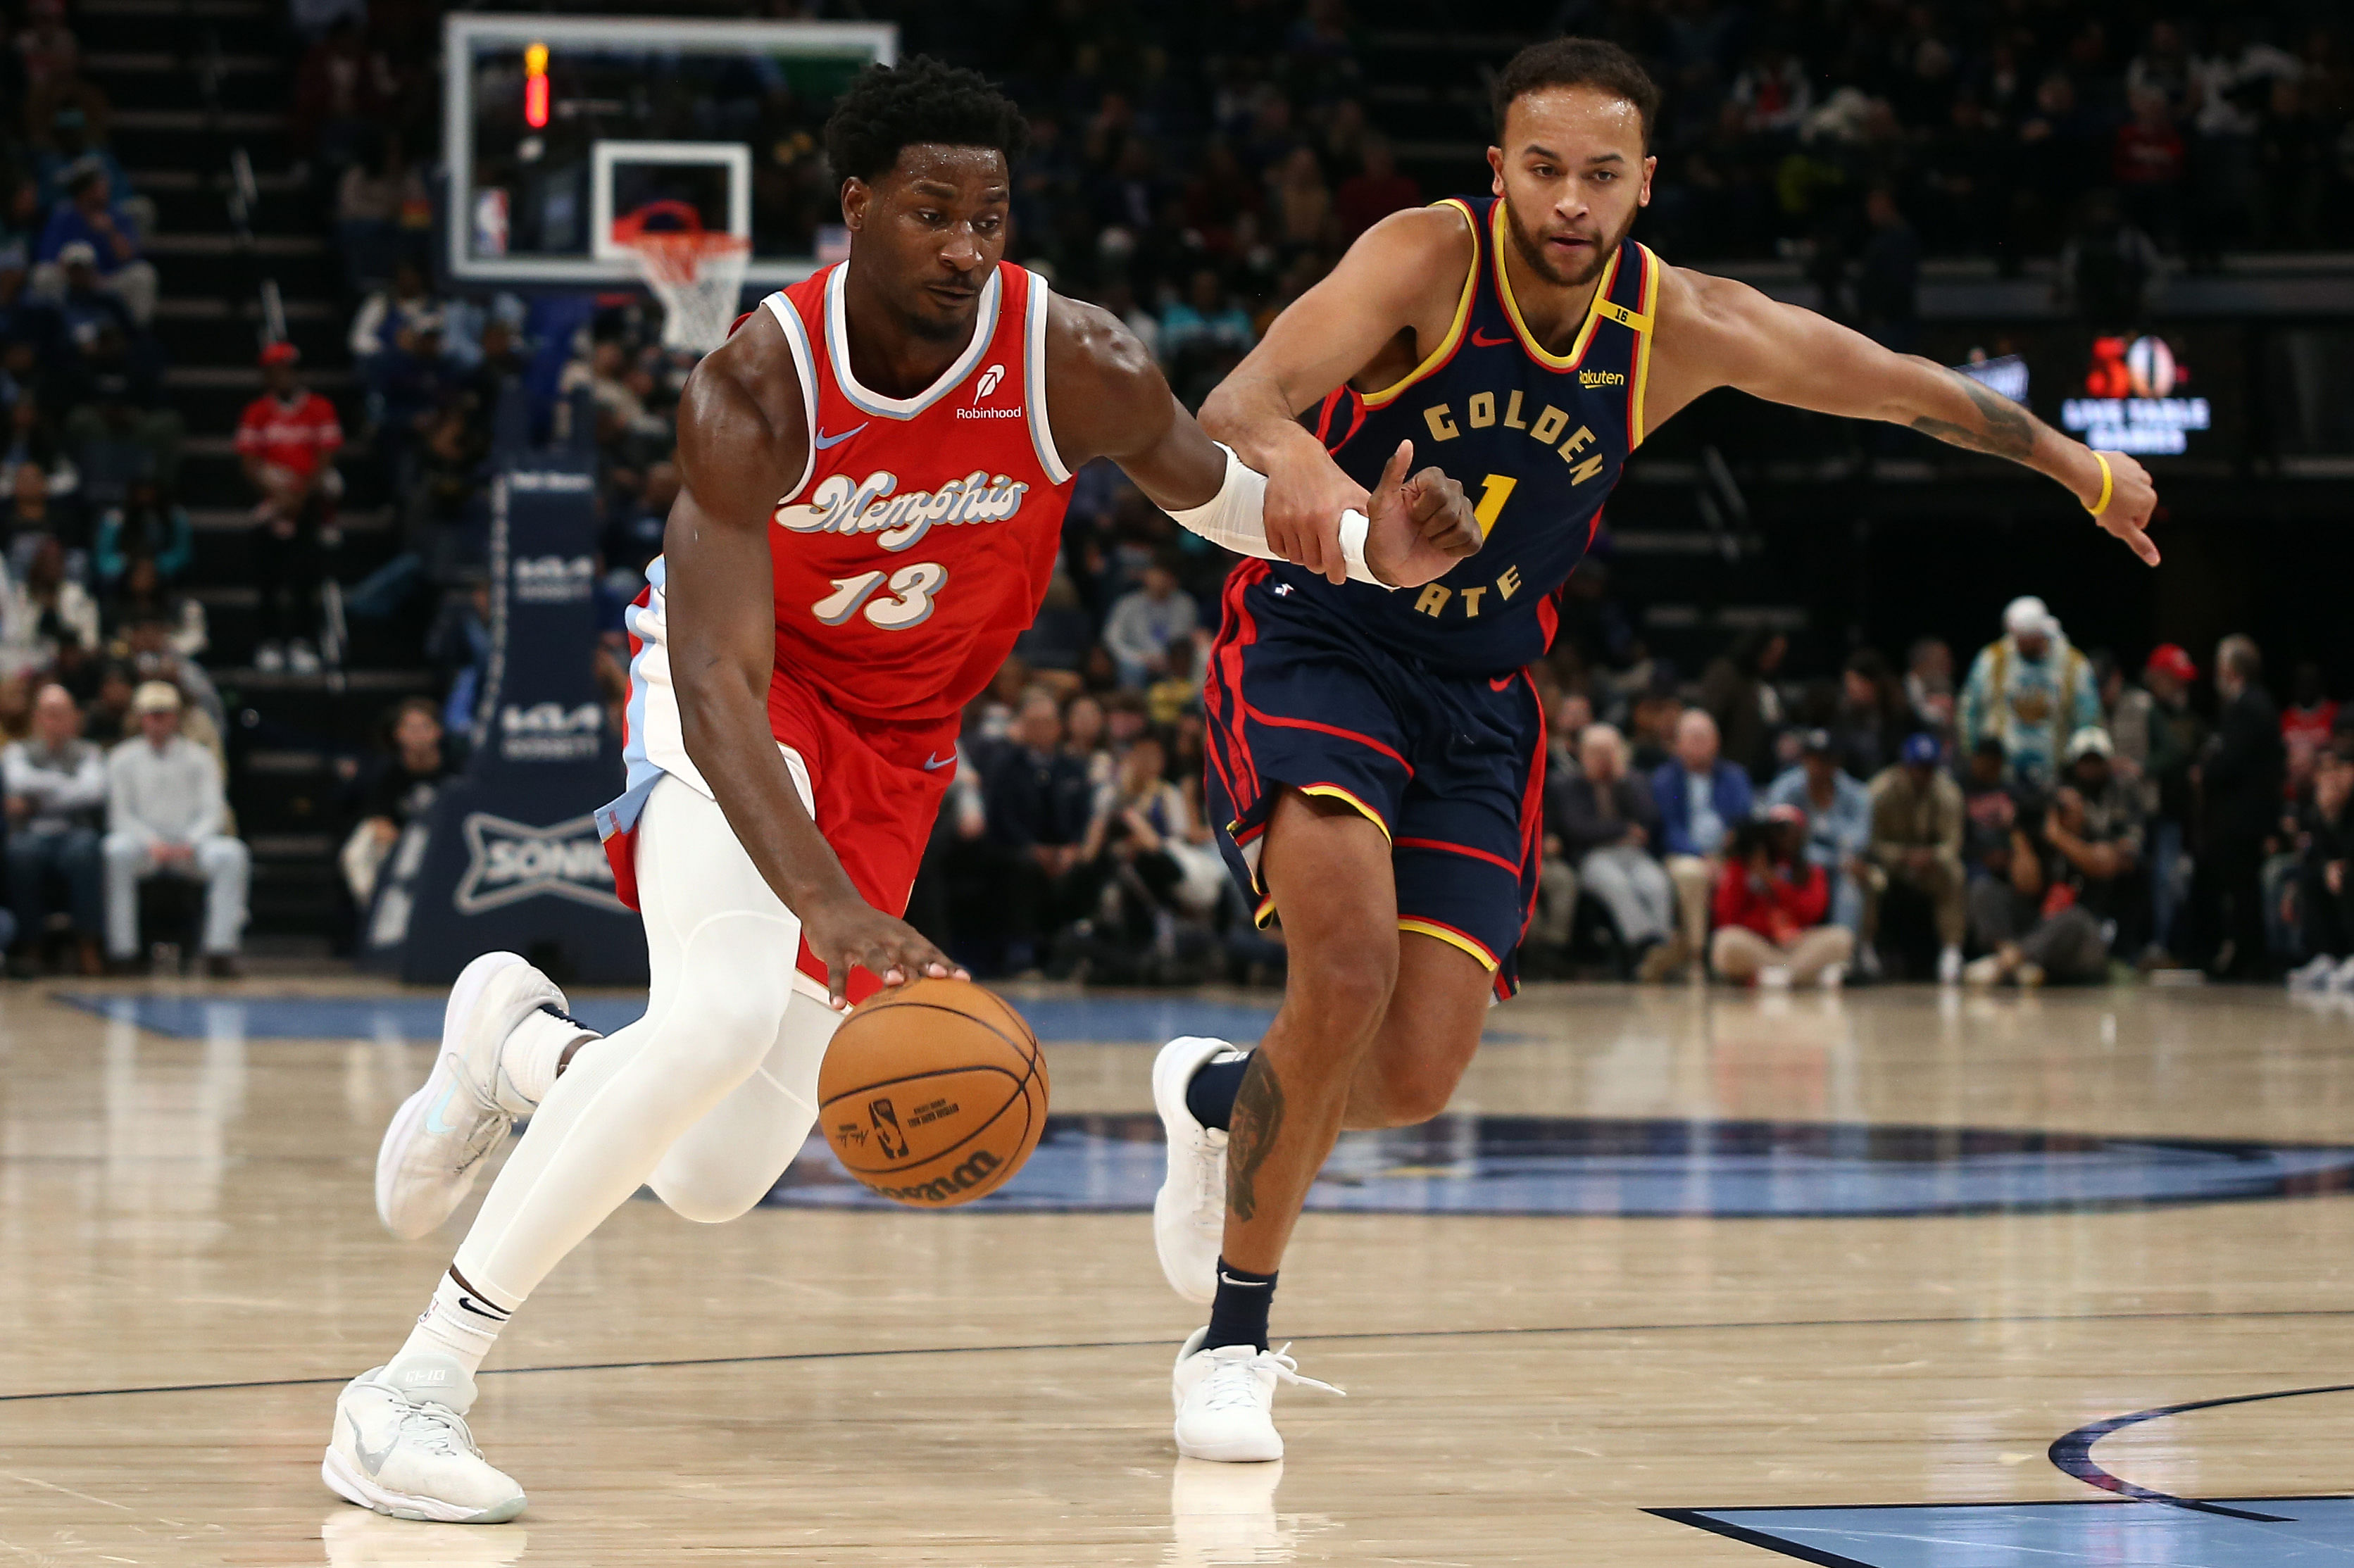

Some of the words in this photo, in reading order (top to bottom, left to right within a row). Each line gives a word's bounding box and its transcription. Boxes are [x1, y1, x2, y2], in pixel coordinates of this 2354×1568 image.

[1615, 308, 1629, 322] 16
[956, 406, 1022, 419] Robinhood
[1423, 389, 1604, 487] GOLDEN
[775, 470, 1029, 552] Memphis
[810, 562, 949, 630] 13
[1414, 565, 1522, 617] ATE
